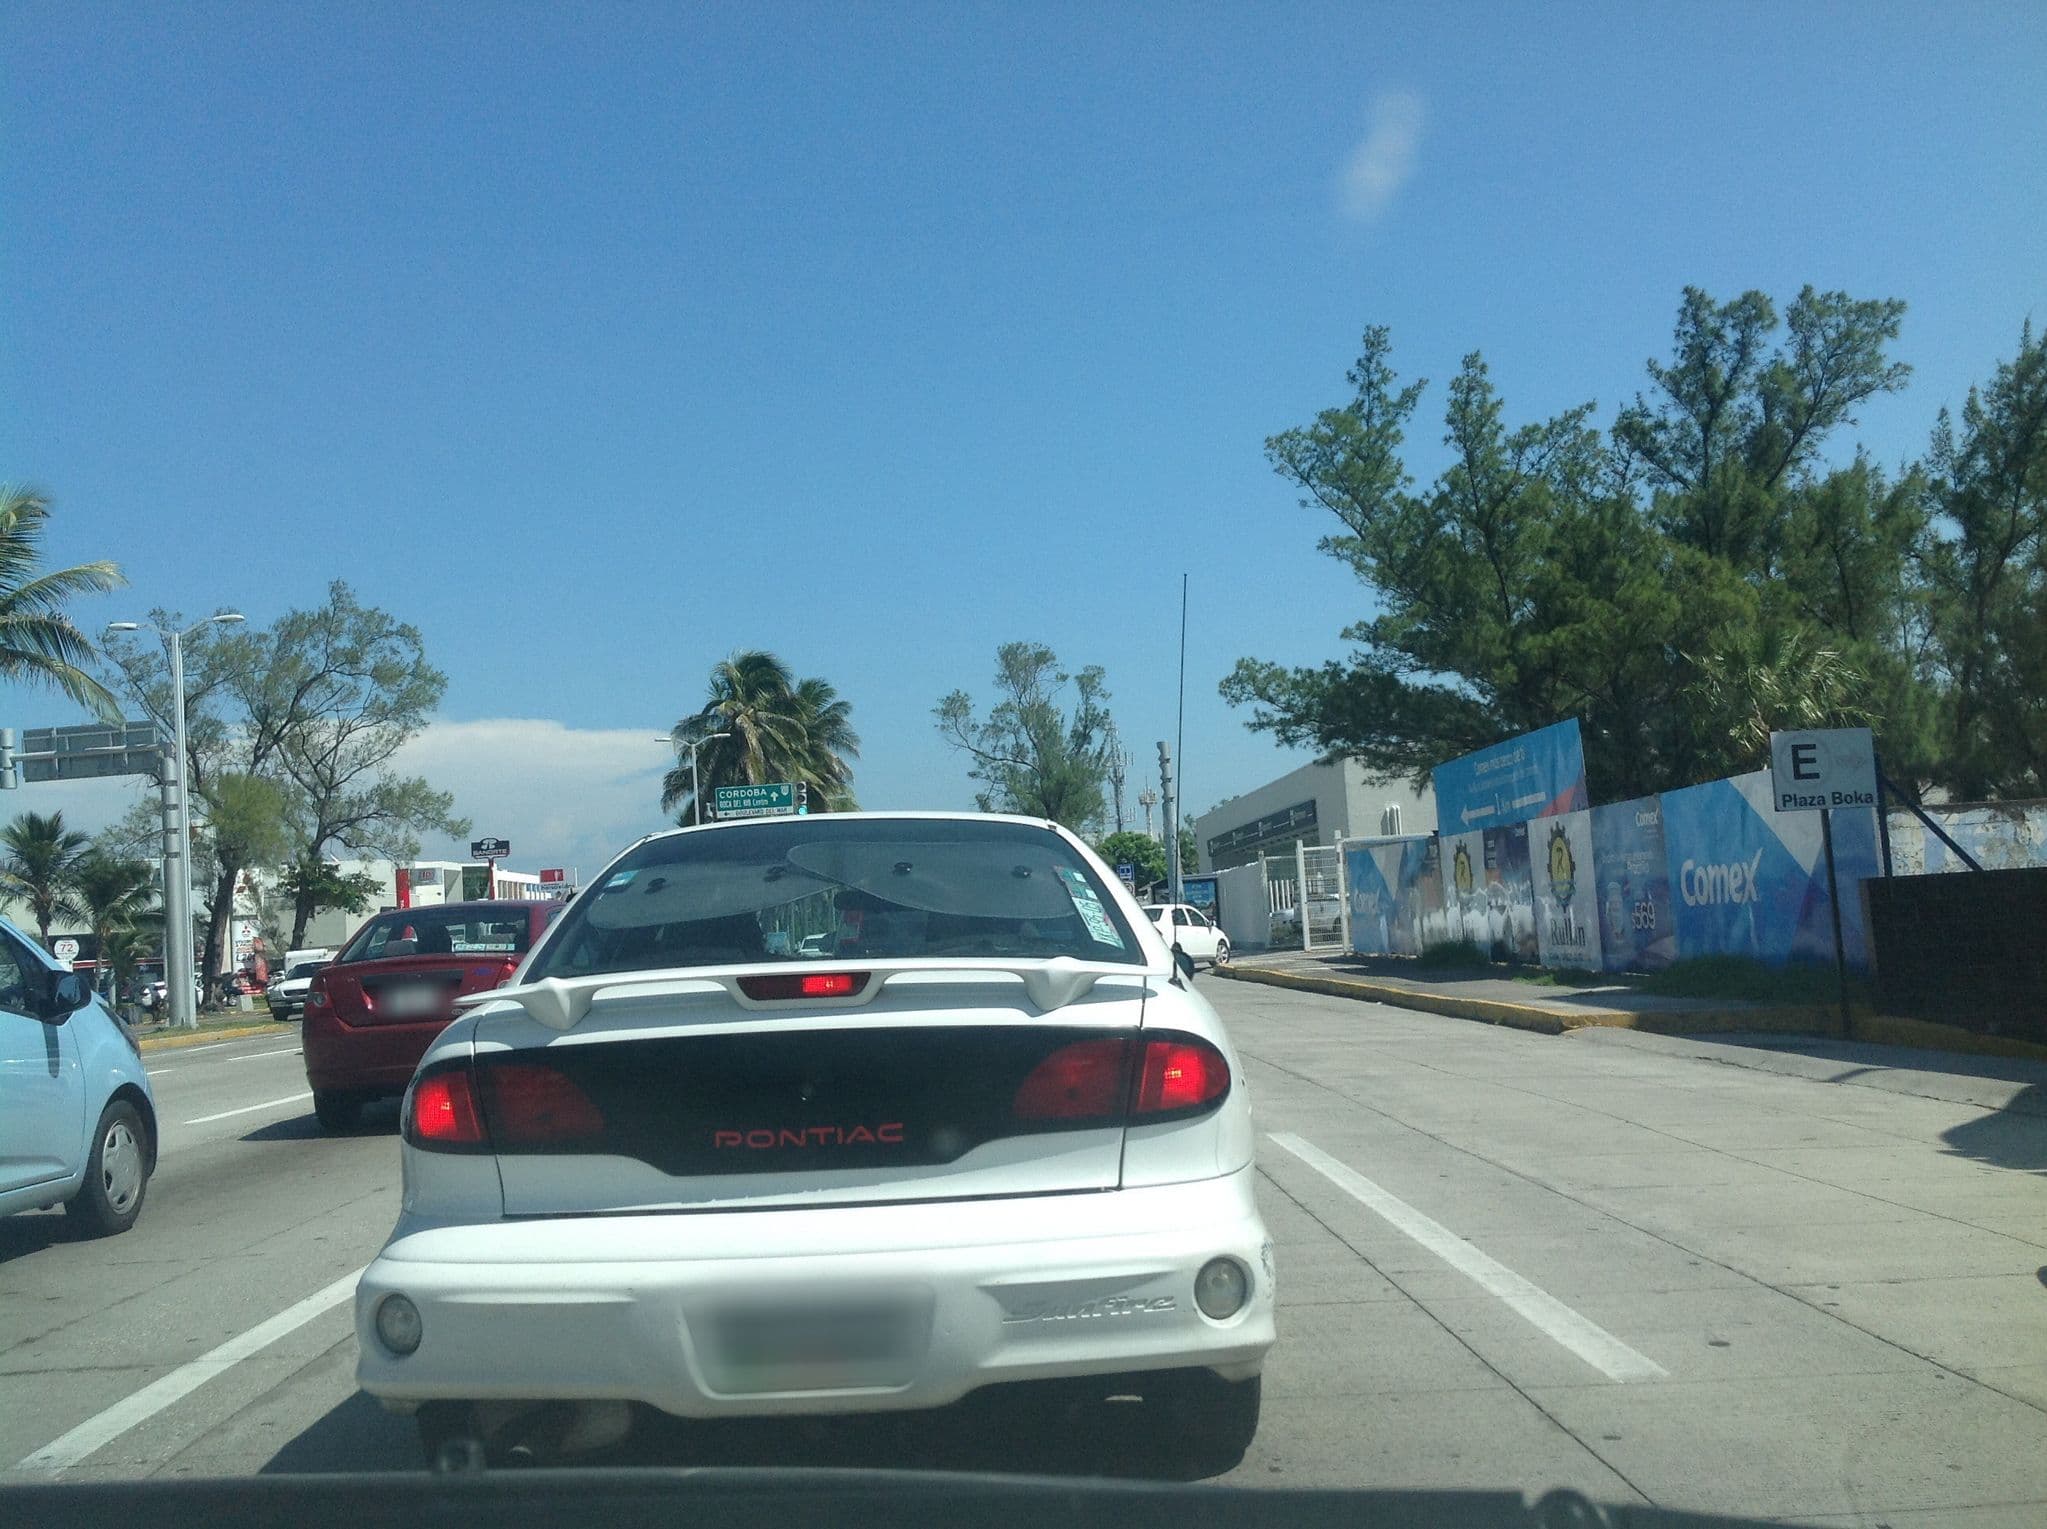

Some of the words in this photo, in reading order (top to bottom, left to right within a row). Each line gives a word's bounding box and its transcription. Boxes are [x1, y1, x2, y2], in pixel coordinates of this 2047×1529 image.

[1792, 744, 1820, 779] E
[719, 788, 767, 799] CORDOBA
[1782, 793, 1826, 807] Plaza
[1831, 790, 1874, 805] Boka
[1635, 808, 1659, 828] Comex
[1681, 848, 1763, 906] Comex
[60, 943, 74, 952] 72
[714, 1122, 904, 1149] PONTIAC
